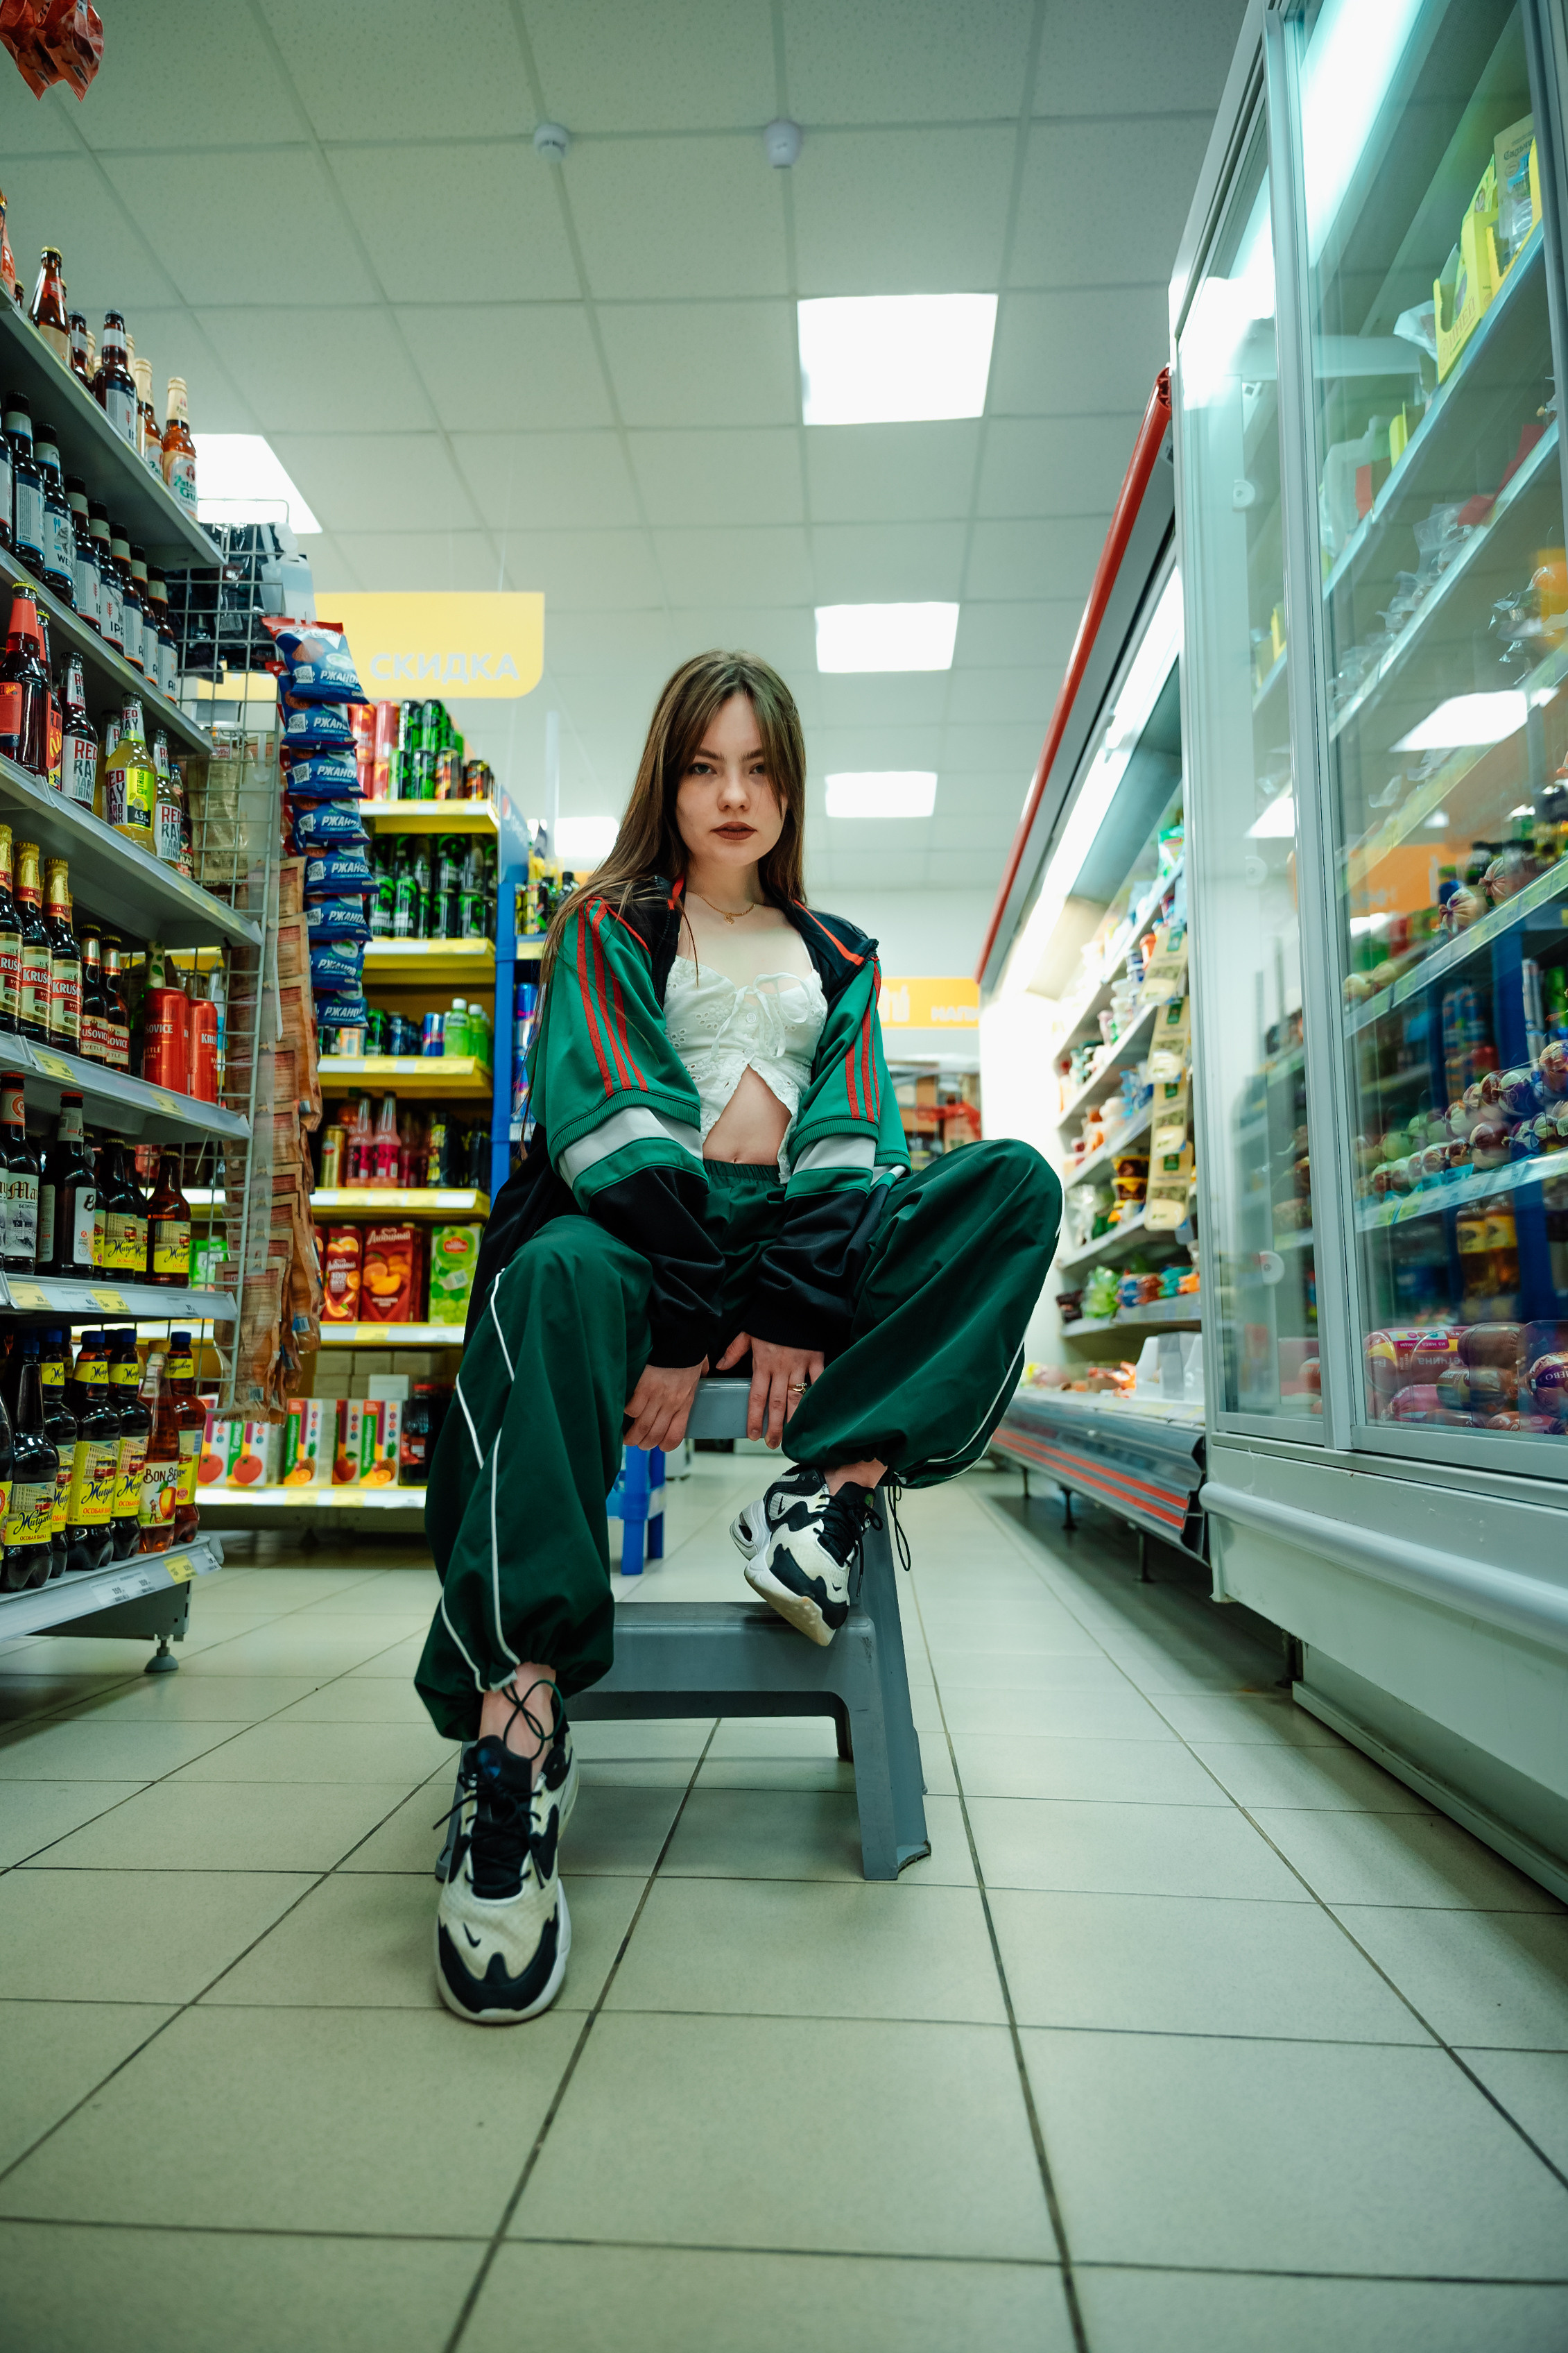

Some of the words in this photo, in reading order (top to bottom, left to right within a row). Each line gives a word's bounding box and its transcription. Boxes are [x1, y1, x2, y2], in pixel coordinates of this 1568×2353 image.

[110, 621, 124, 636] IPA
[370, 653, 520, 685] СКИДКА
[74, 739, 97, 760] RED
[73, 759, 96, 780] RAY
[137, 771, 145, 795] CITRUS
